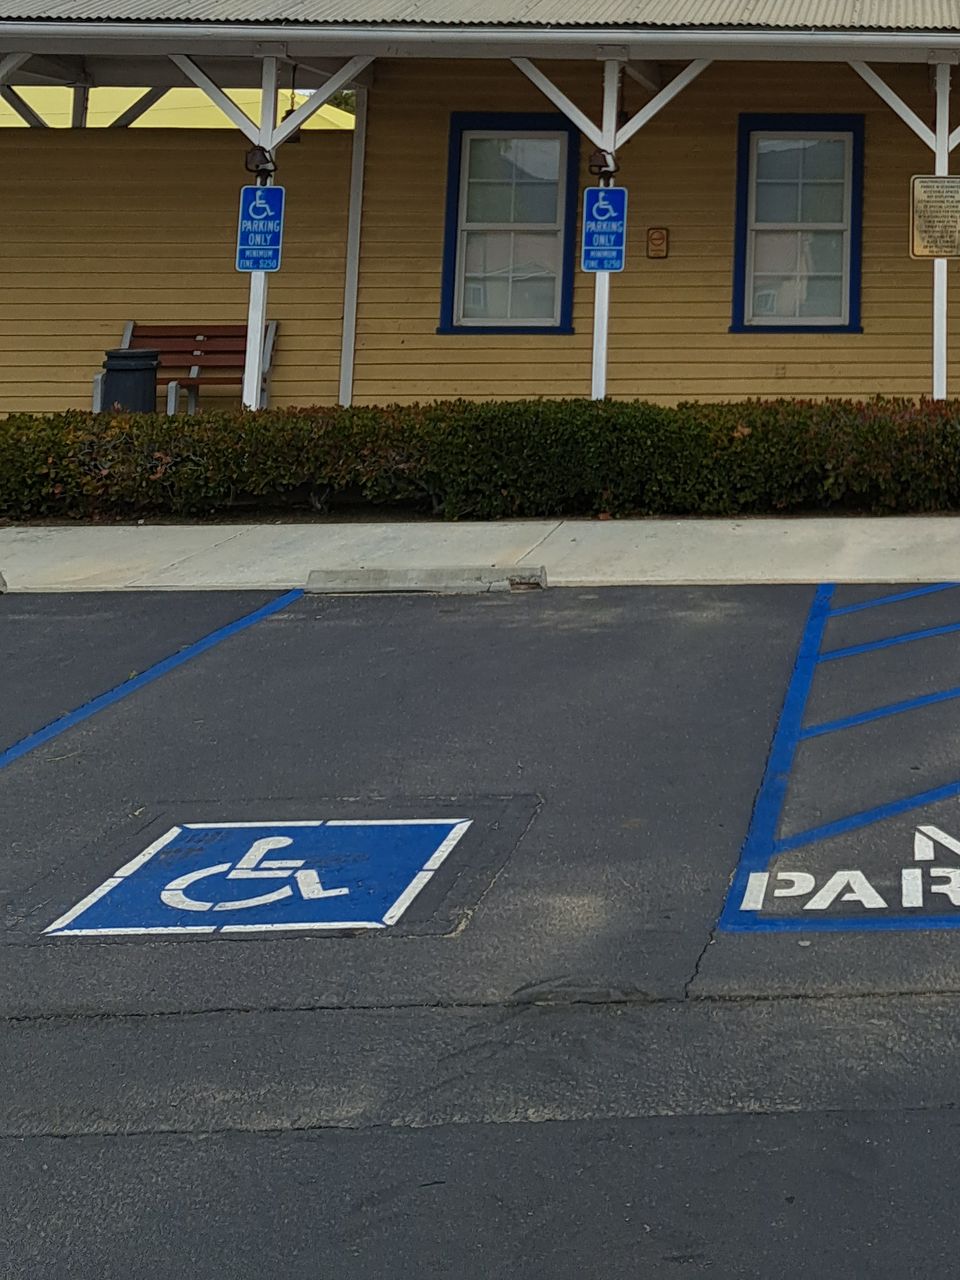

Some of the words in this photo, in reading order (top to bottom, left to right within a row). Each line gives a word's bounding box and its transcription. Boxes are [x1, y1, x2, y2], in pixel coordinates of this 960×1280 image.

[242, 220, 280, 232] PARKING
[586, 221, 623, 233] PARKING
[248, 233, 272, 245] ONLY
[593, 234, 616, 246] ONLY
[245, 250, 273, 258] MINIMUM
